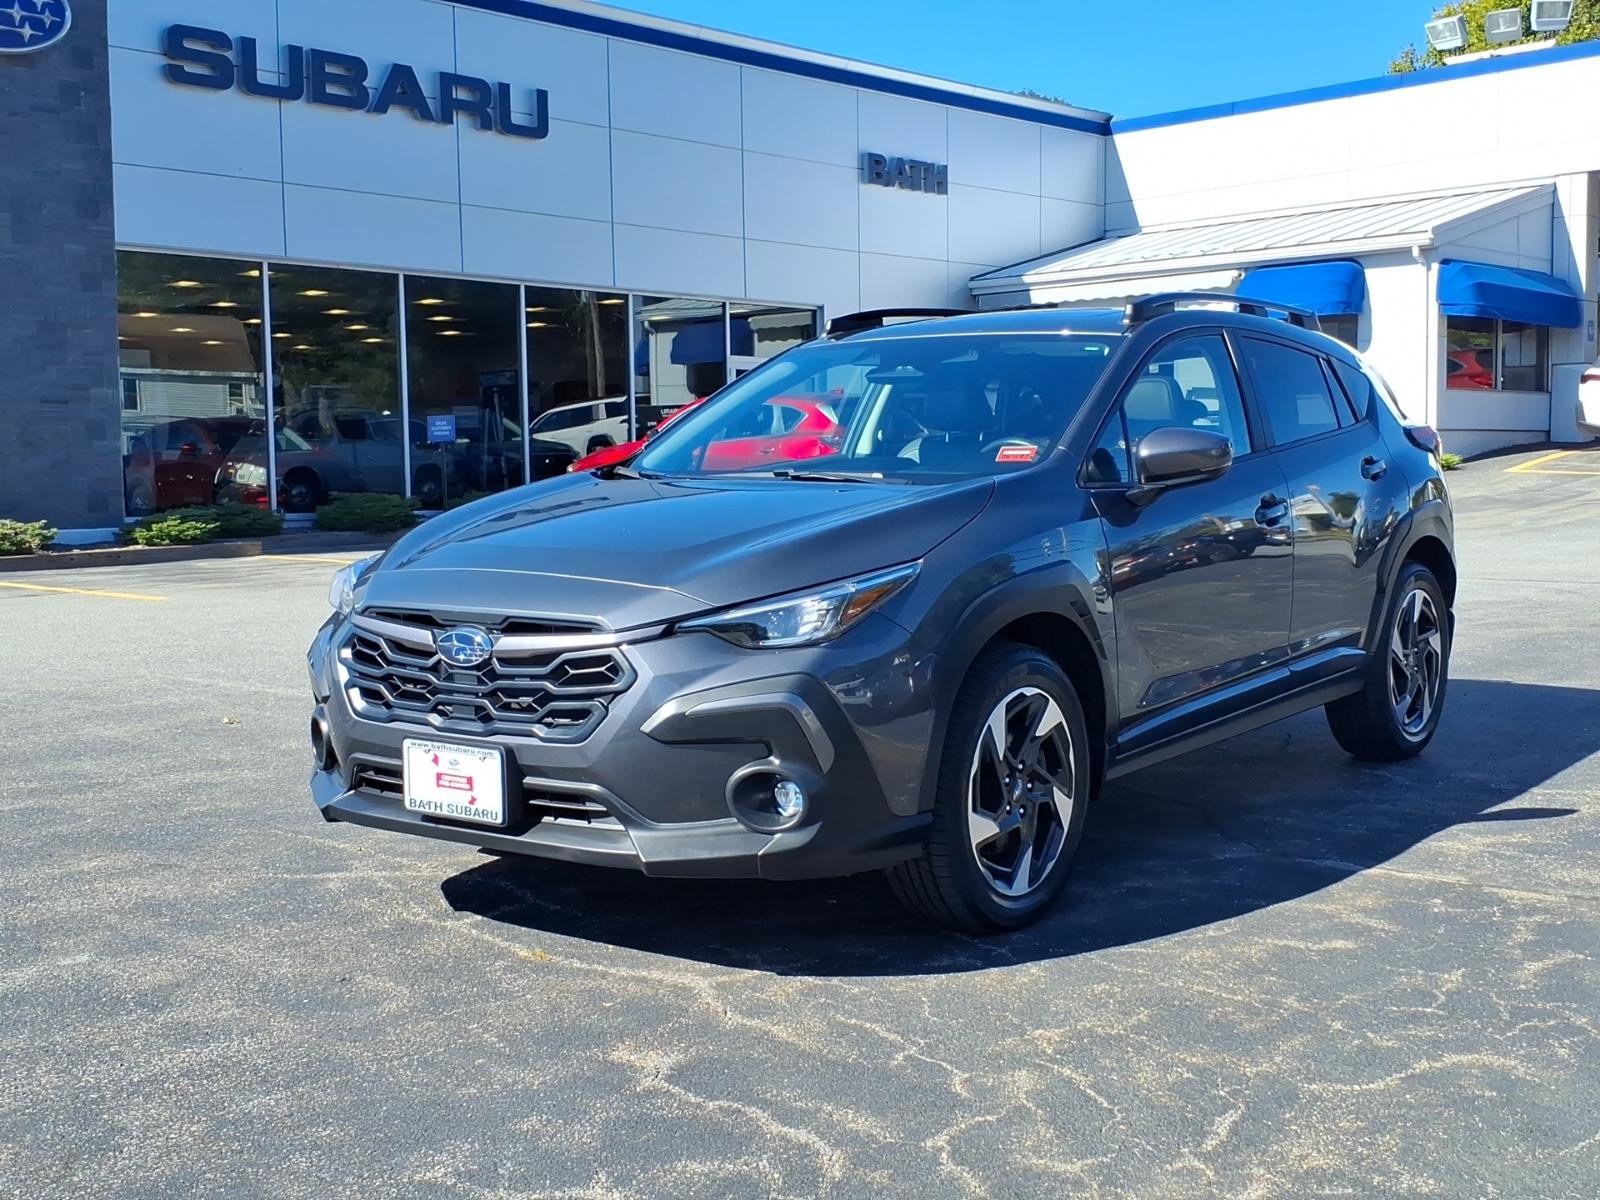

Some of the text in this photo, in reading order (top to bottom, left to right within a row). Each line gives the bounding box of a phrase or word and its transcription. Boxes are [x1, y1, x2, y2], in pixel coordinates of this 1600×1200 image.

[164, 24, 549, 139] SUBARU
[861, 152, 948, 195] BATH
[410, 741, 494, 757] www.bathsubaru.com
[409, 798, 499, 821] BATH SUBARU
